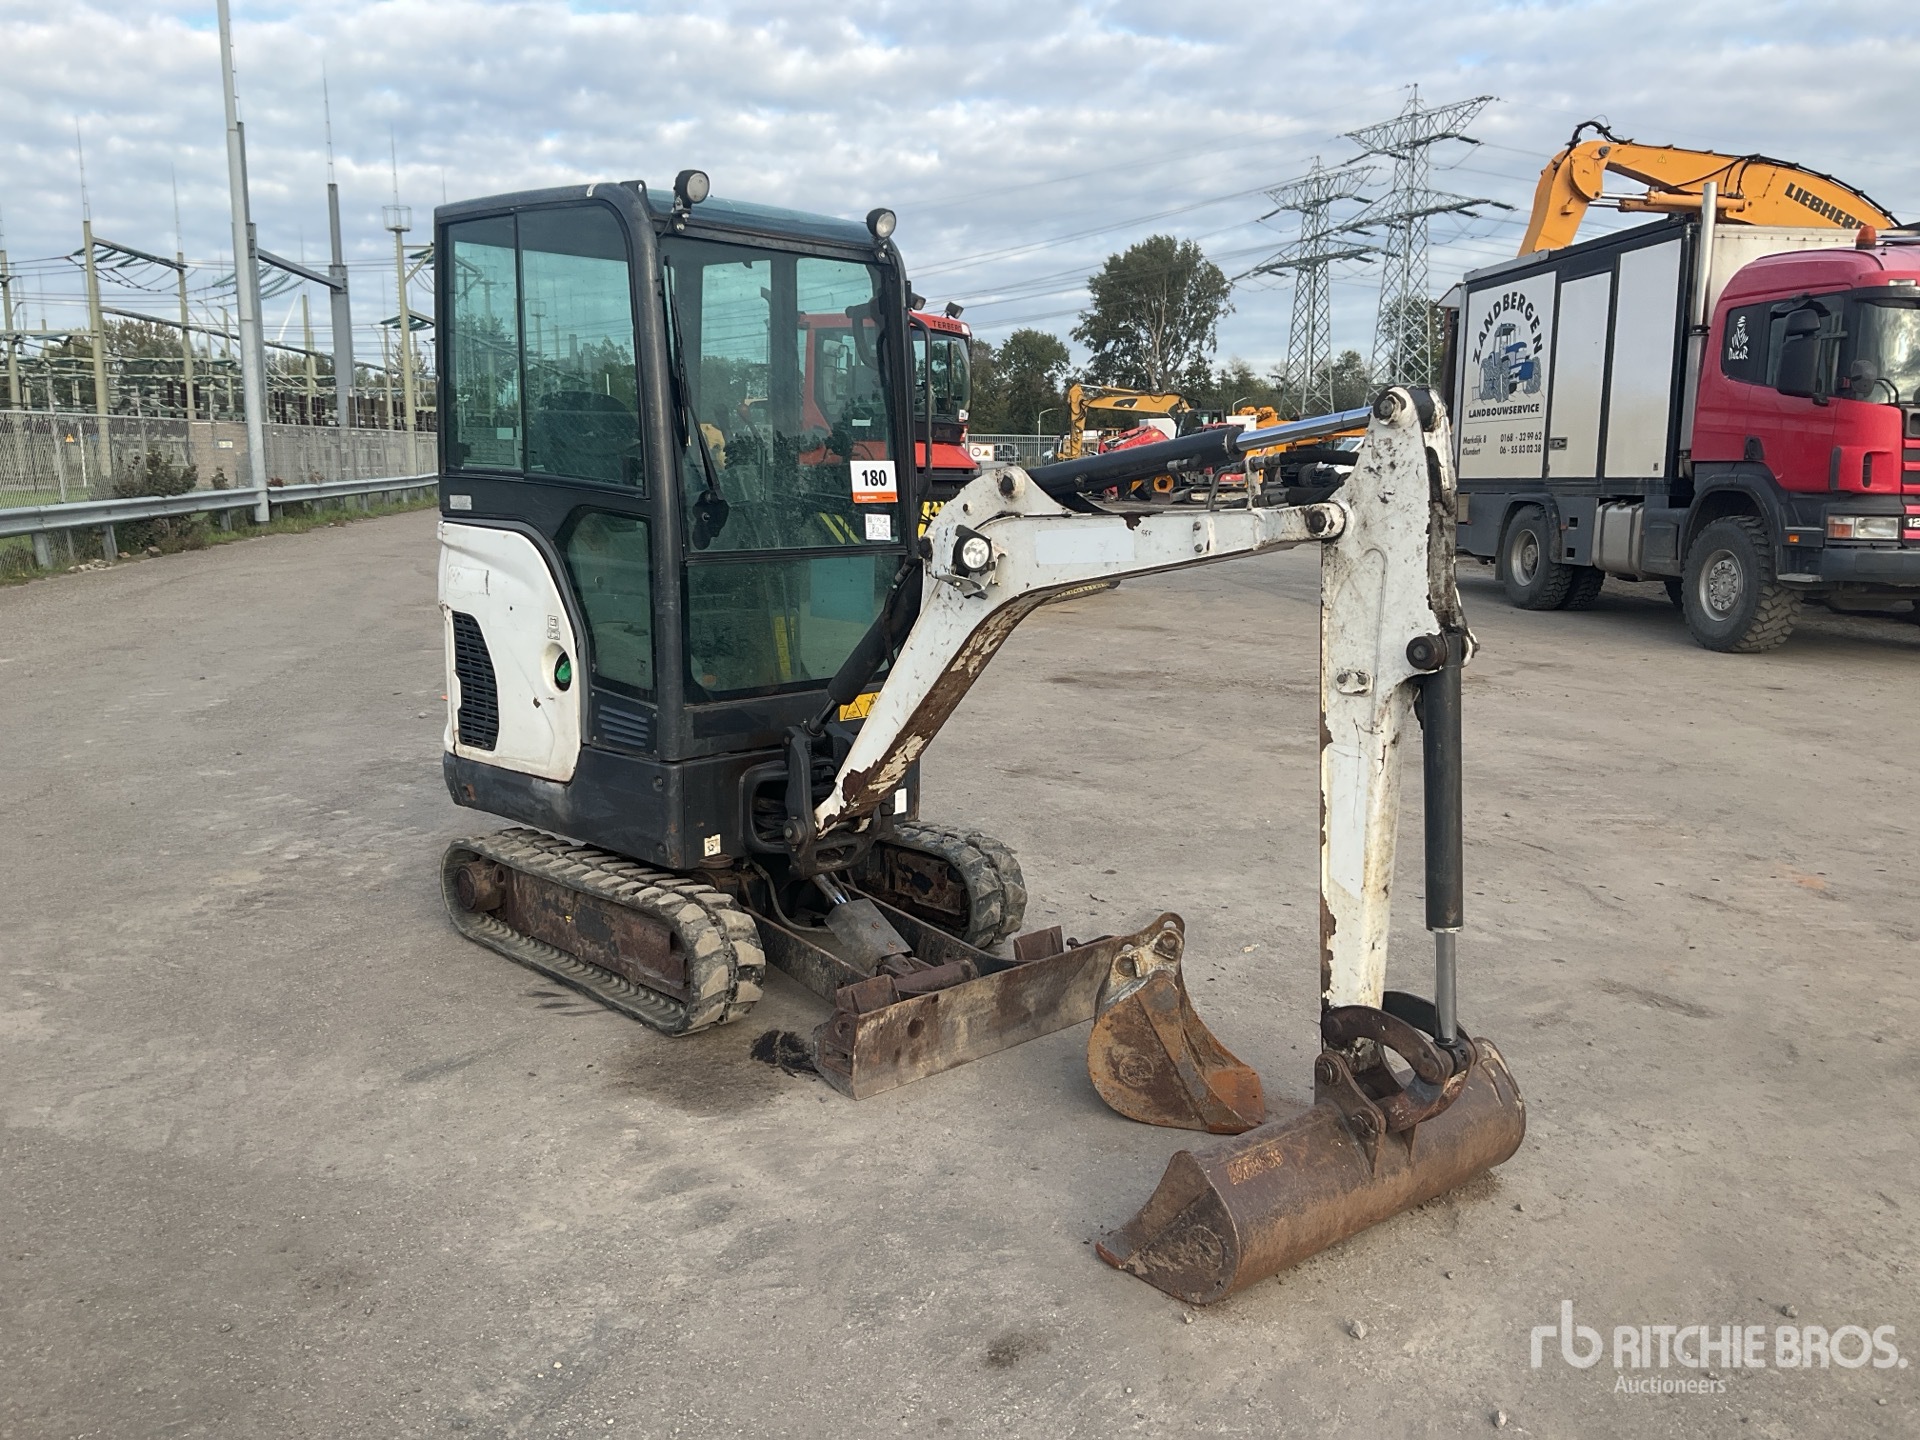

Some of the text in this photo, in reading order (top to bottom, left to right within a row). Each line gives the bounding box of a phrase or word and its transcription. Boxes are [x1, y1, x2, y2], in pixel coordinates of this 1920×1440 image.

[1473, 292, 1543, 365] ZANDBERGEN
[1468, 403, 1540, 418] LANDBOUWSERVICE
[1500, 433, 1514, 442] 0168
[1500, 446, 1507, 454] 06
[861, 469, 887, 487] 180
